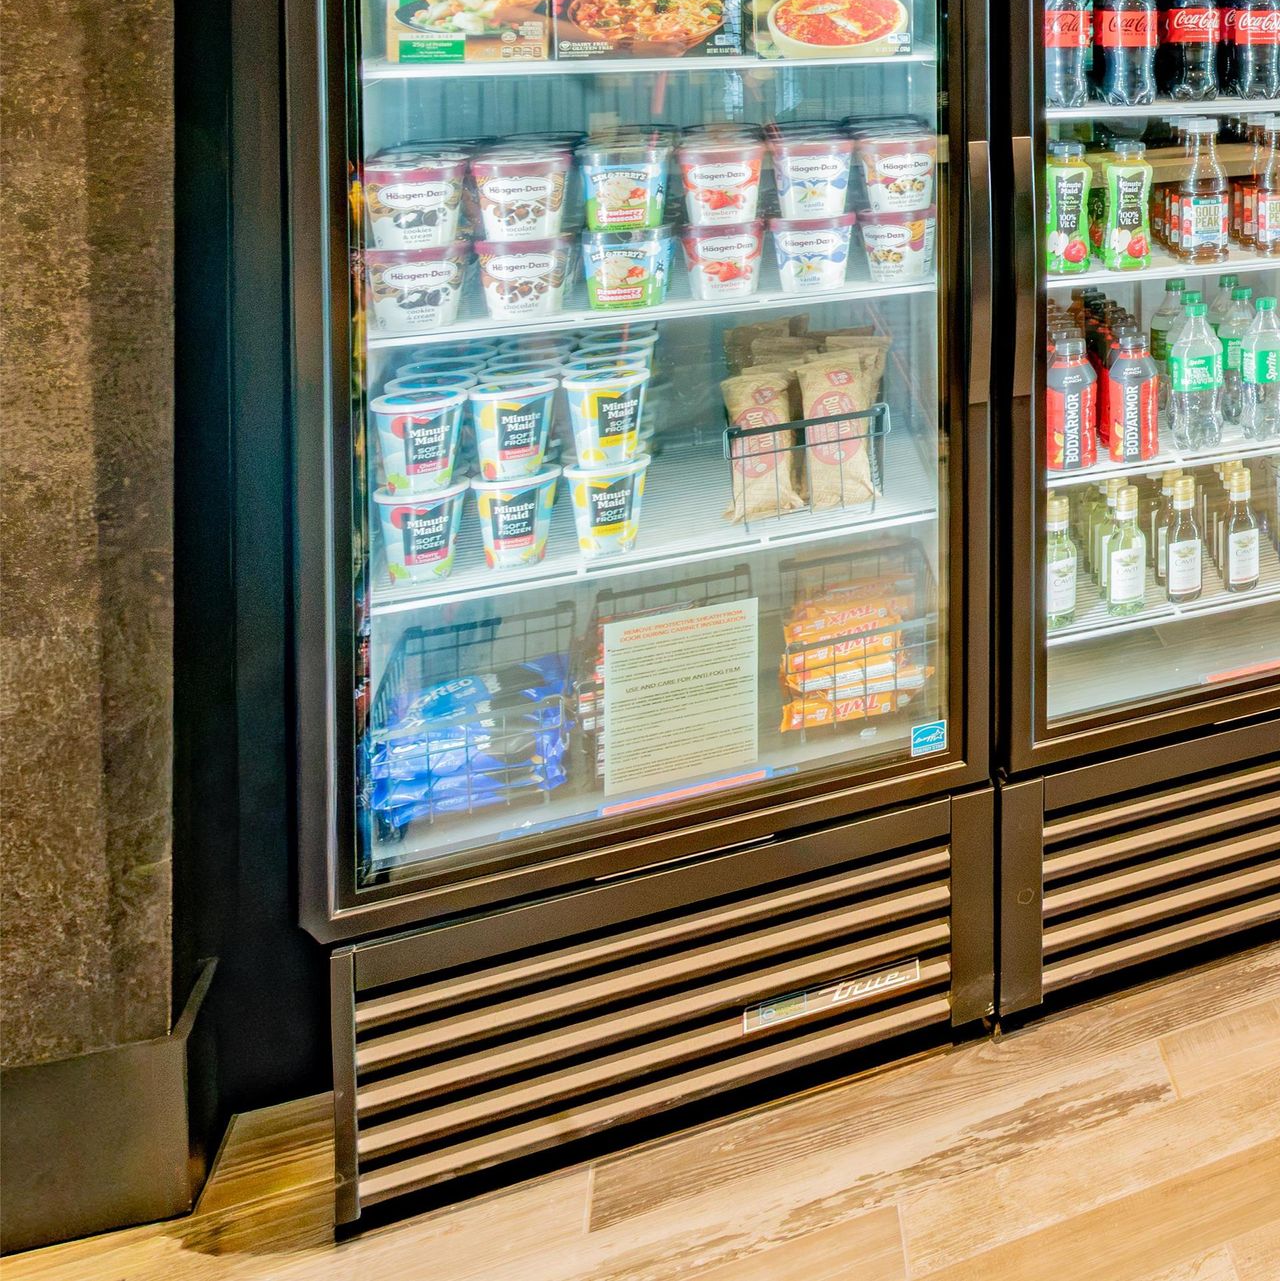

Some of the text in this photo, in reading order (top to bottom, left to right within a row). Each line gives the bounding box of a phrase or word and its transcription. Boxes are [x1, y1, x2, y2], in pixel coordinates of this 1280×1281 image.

[883, 160, 928, 170] Häagen-Dazs
[386, 188, 448, 200] Häagen-Dazs
[489, 185, 546, 195] Häagen-Dazs
[1196, 206, 1219, 216] GOLD
[1060, 213, 1076, 221] 100%
[1196, 216, 1219, 227] PEAK
[1060, 220, 1069, 228] Vit
[702, 242, 753, 253] Häagen-Dazs
[391, 270, 450, 282] Häagen-Dazs
[1266, 352, 1277, 380] Sprite
[602, 399, 638, 412] Minute
[501, 412, 541, 424] Minute
[608, 407, 634, 419] Maid
[610, 418, 632, 427] SOFT
[1127, 385, 1139, 456] BODYARMOR
[409, 424, 450, 438] Minute
[507, 421, 536, 432] Maid
[605, 423, 635, 433] FROZEN
[1066, 393, 1079, 463] BODYARMOR
[415, 434, 445, 446] Maid
[509, 432, 534, 440] SOFT
[504, 437, 537, 447] FROZEN
[417, 445, 442, 453] SOFT
[412, 450, 446, 460] FROZEN
[419, 461, 441, 469] Cherry
[592, 489, 631, 501] Minute
[494, 502, 535, 515] Minute
[597, 498, 625, 509] Maid
[500, 511, 528, 521] Maid
[596, 512, 627, 522] FROZEN
[600, 508, 624, 516] SOFT
[407, 515, 449, 529] Minute
[503, 522, 528, 530] SOFT
[413, 524, 443, 536] Maid
[499, 526, 531, 536] FROZEN
[416, 535, 442, 544] SOFT
[411, 540, 446, 551] FROZEN
[623, 625, 653, 636] REMOVE
[655, 618, 696, 631] PROTECTIVE
[620, 634, 641, 643] DOOR
[671, 624, 699, 634] CABINET
[640, 683, 656, 691] AND
[657, 679, 676, 687] CARE
[677, 675, 691, 683] FOR
[725, 666, 741, 674] FILM
[834, 694, 881, 717] Twix
